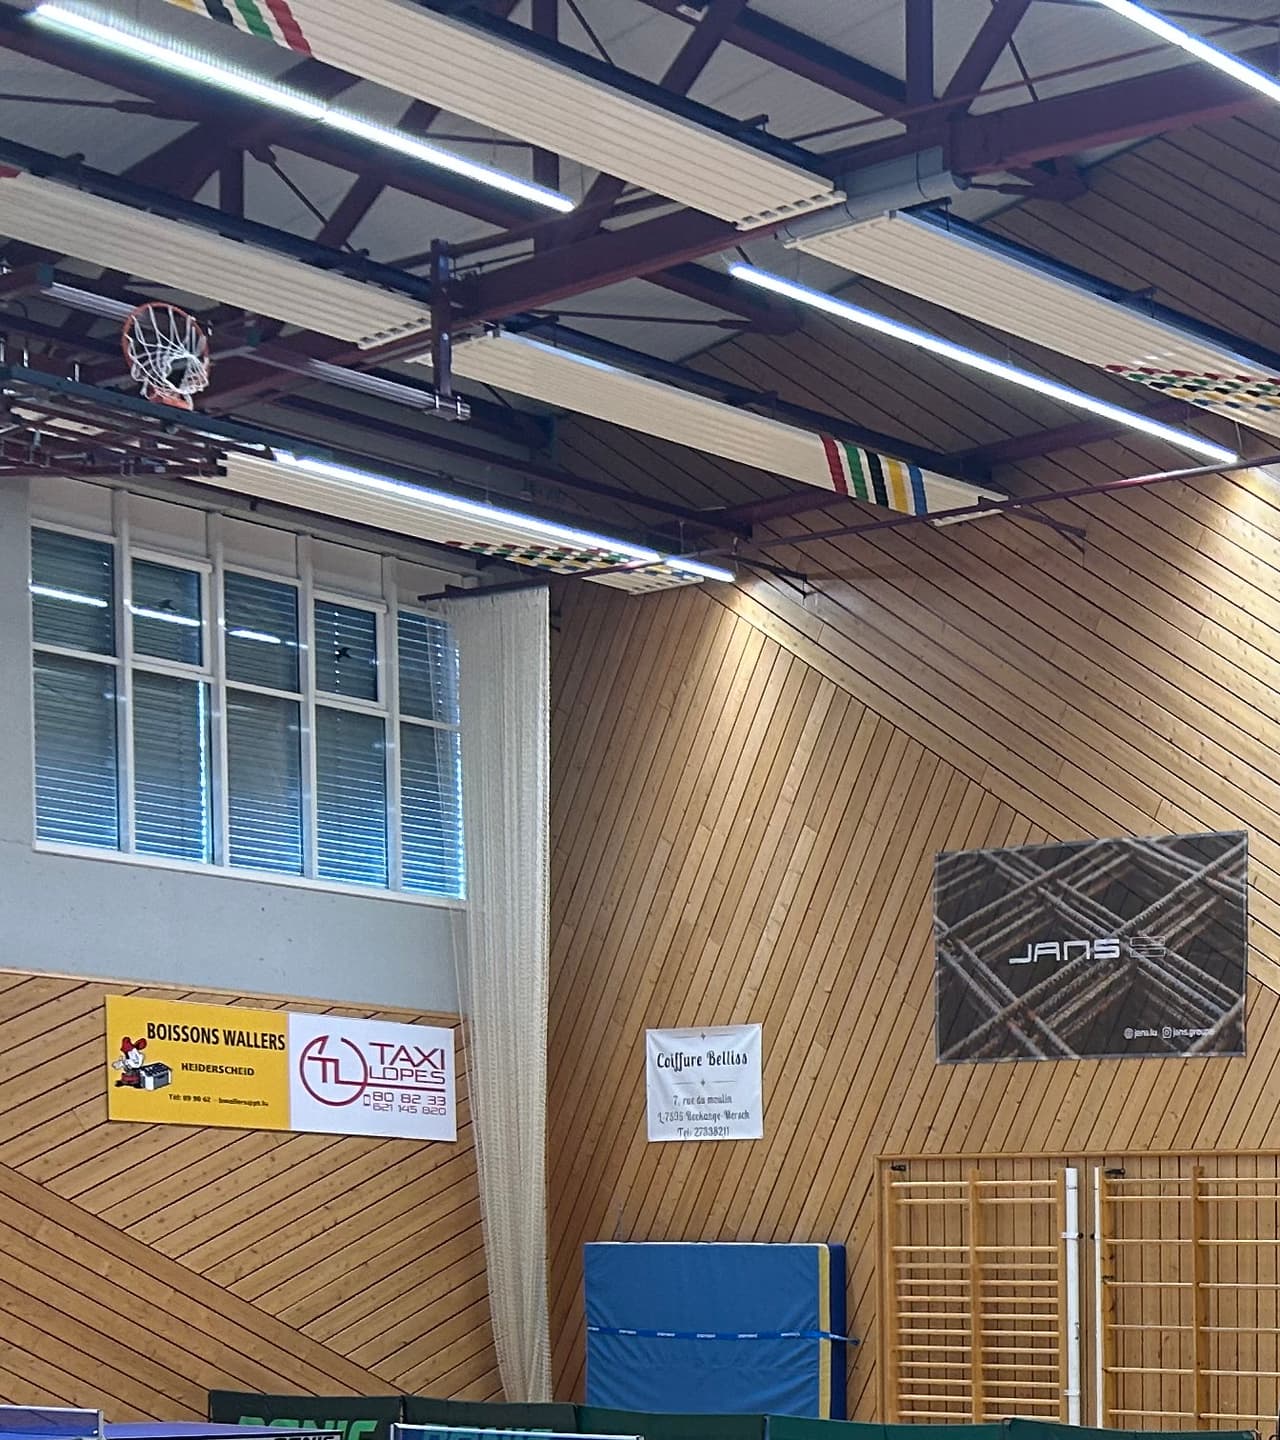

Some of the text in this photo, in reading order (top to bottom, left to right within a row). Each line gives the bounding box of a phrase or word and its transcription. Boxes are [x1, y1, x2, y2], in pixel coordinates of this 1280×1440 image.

[147, 1022, 286, 1050] BOISSONS WALLERS
[369, 1042, 446, 1070] TAXI
[657, 1050, 748, 1072] Coiffure Belliss
[181, 1063, 255, 1076] HEIDERSCHEID
[369, 1066, 446, 1084] LOPES
[372, 1092, 446, 1106] 80 82 33
[372, 1103, 393, 1112] 621
[397, 1104, 418, 1114] 145
